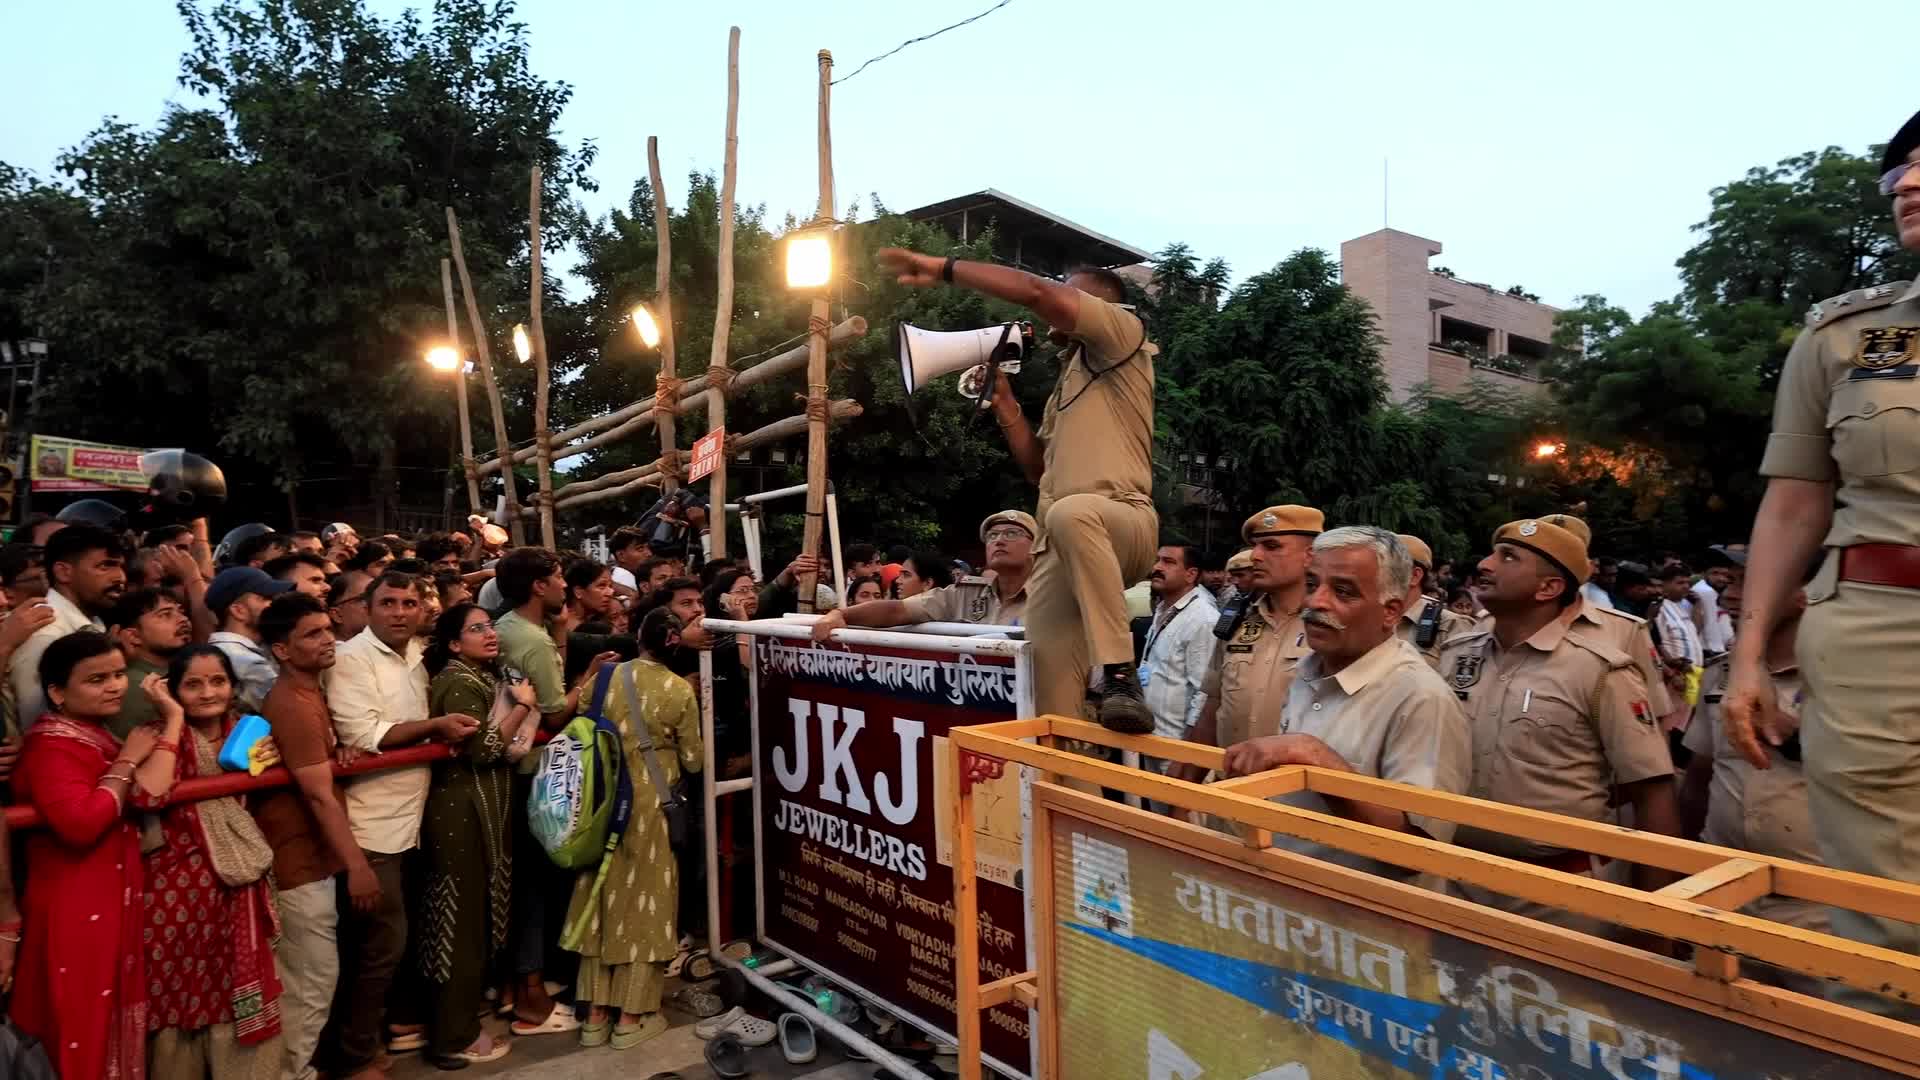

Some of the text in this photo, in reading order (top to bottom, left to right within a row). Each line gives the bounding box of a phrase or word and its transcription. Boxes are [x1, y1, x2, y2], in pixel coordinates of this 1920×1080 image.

[865, 655, 937, 692] यातायात
[772, 698, 925, 825] JKJ
[774, 799, 927, 881] JEWELLERS
[794, 874, 819, 895] ROAD
[825, 888, 888, 930] MANSAROVAR
[1172, 871, 1409, 998] यातायात
[910, 944, 950, 972] NAGAR
[979, 956, 1021, 978] JAGA
[1282, 976, 1375, 1038] सुगम
[1383, 1018, 1441, 1068] एवं
